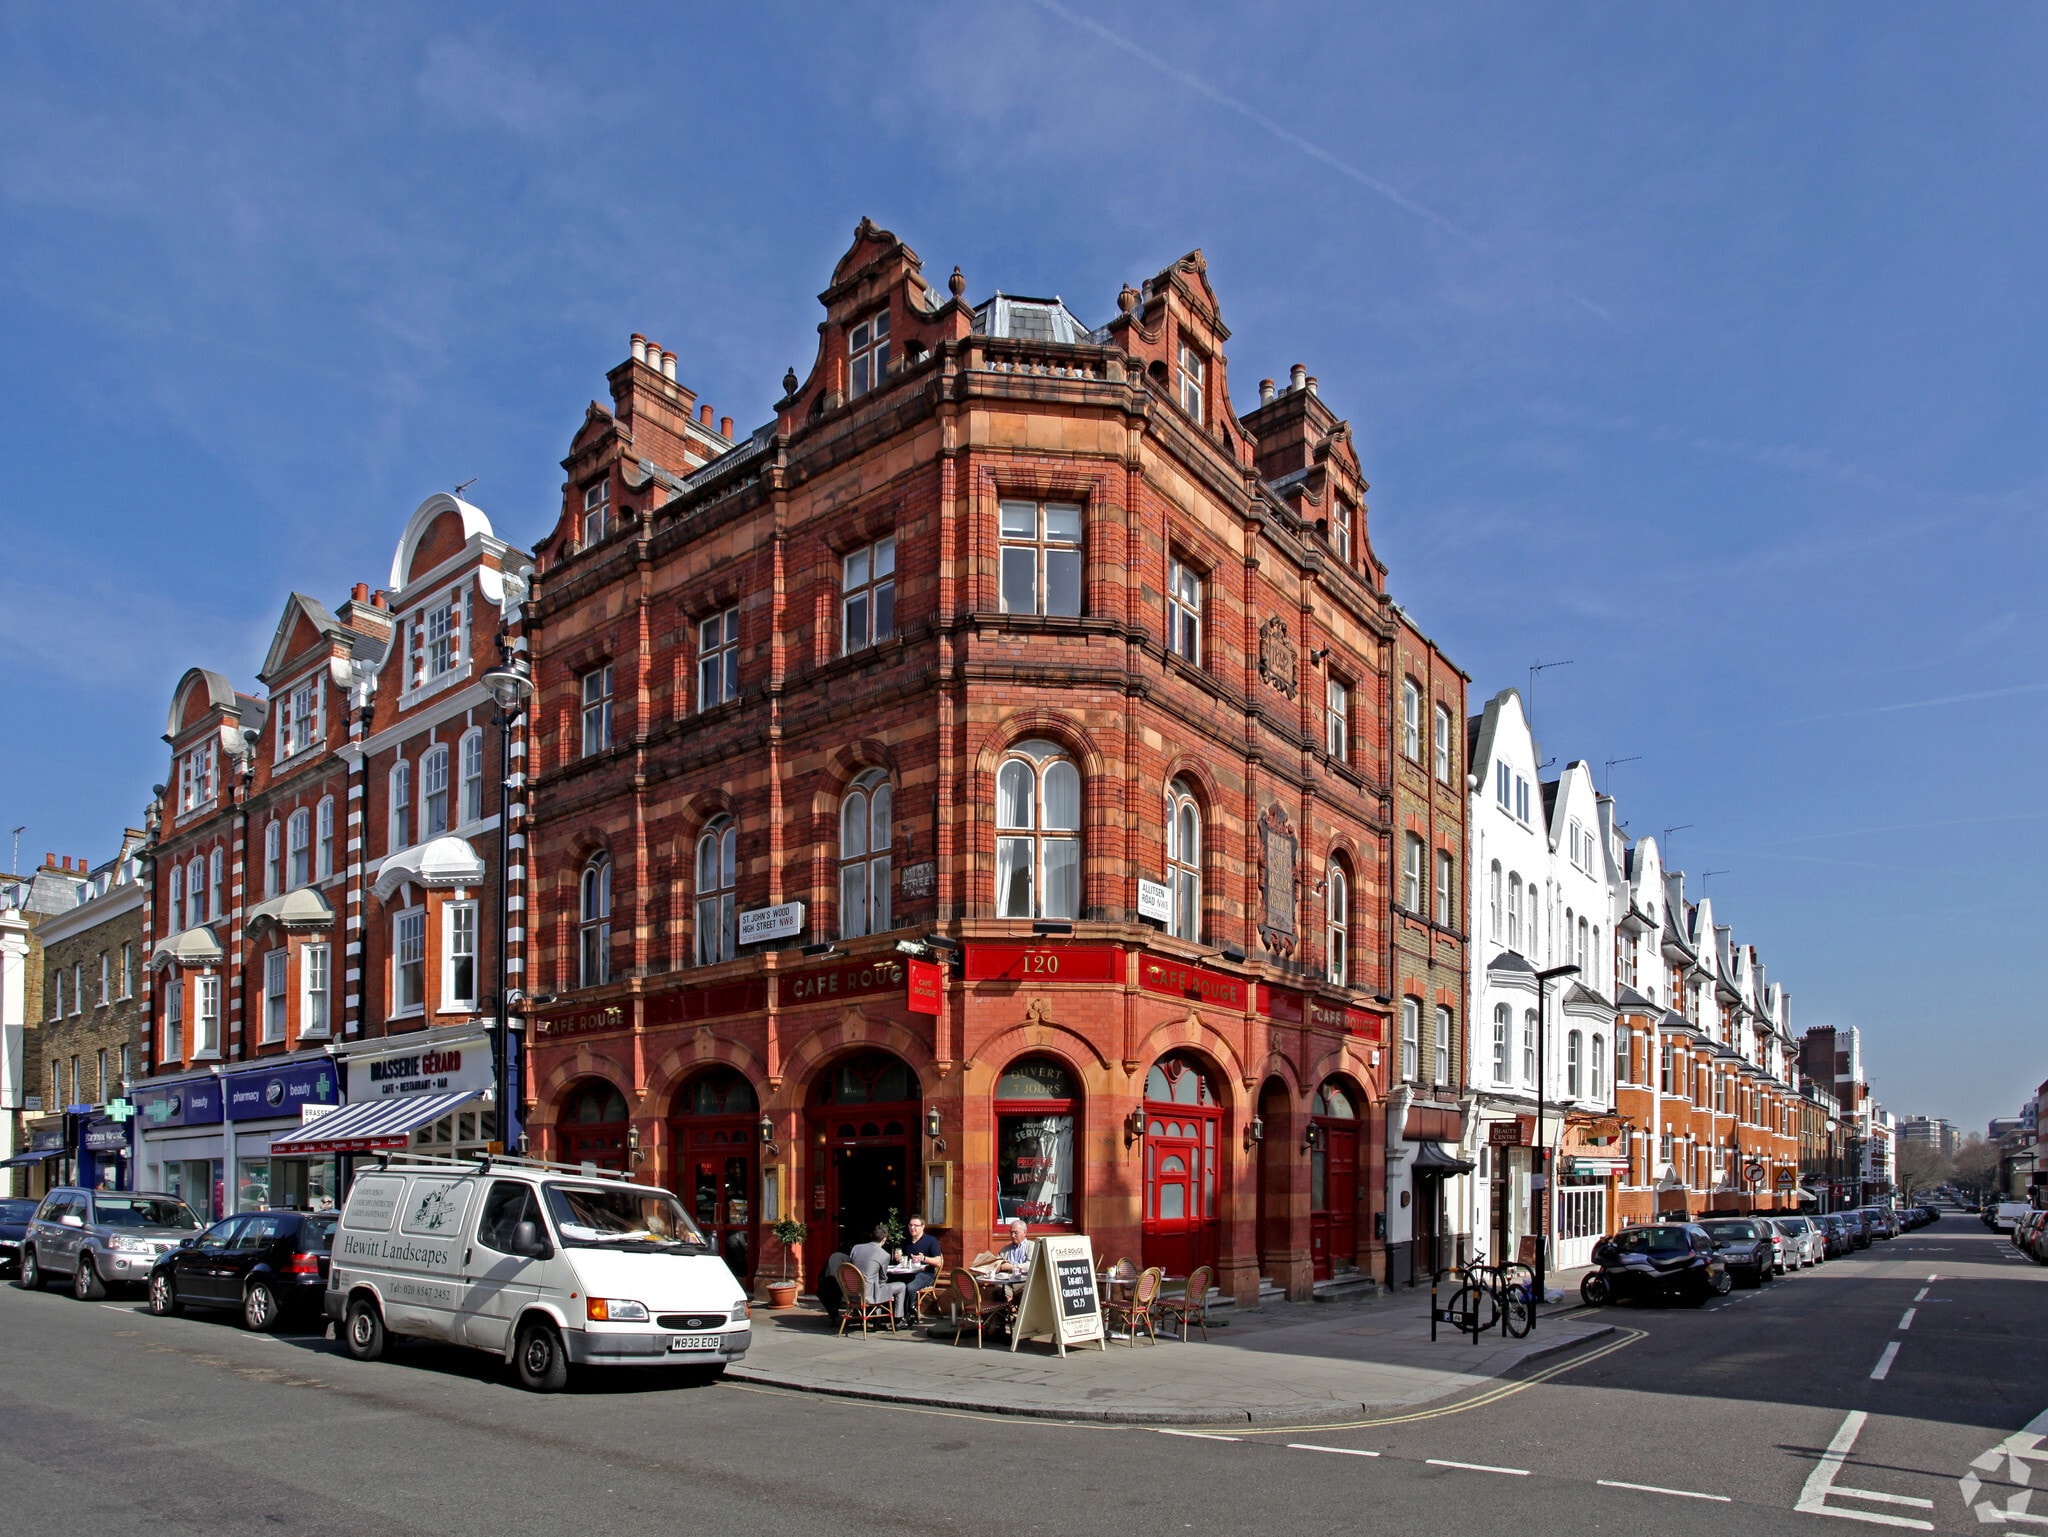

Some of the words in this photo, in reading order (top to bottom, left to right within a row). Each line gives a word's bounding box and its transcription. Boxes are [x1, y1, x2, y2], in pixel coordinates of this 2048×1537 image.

[1142, 884, 1164, 898] ALLITSEN
[1142, 894, 1156, 906] ROAD
[1156, 899, 1168, 910] NW8
[751, 911, 770, 922] JOHN'S
[773, 906, 790, 918] WOOD
[742, 924, 755, 934] HIGH
[756, 919, 776, 931] STREET
[780, 916, 794, 926] NW8
[1022, 955, 1059, 974] 120
[848, 964, 903, 989] ROUG
[914, 986, 937, 998] ROUGE
[1192, 976, 1237, 1003] ROUGE
[580, 1011, 624, 1030] ROUGE
[1344, 1014, 1374, 1036] ROUGE
[370, 1055, 420, 1082] BRASSERIE
[422, 1050, 462, 1075] GÉRARD
[1010, 1066, 1063, 1080] OUVERT
[233, 1090, 260, 1104] pharmacy
[290, 1082, 310, 1096] beauty
[400, 1079, 430, 1092] RESTAURANT
[438, 1078, 448, 1088] BAR
[1014, 1084, 1019, 1094] 7
[1024, 1084, 1061, 1094] JOURS
[191, 1097, 208, 1109] beauty
[304, 1108, 332, 1116] BRASSE
[344, 1235, 379, 1257] Hewitt
[382, 1240, 448, 1268] Landscapes
[390, 1282, 402, 1293] Tel:
[403, 1284, 415, 1295] 020
[416, 1286, 432, 1297] 8547
[434, 1288, 451, 1300] 2452
[674, 1338, 700, 1348] W832
[702, 1337, 719, 1348] EOB
